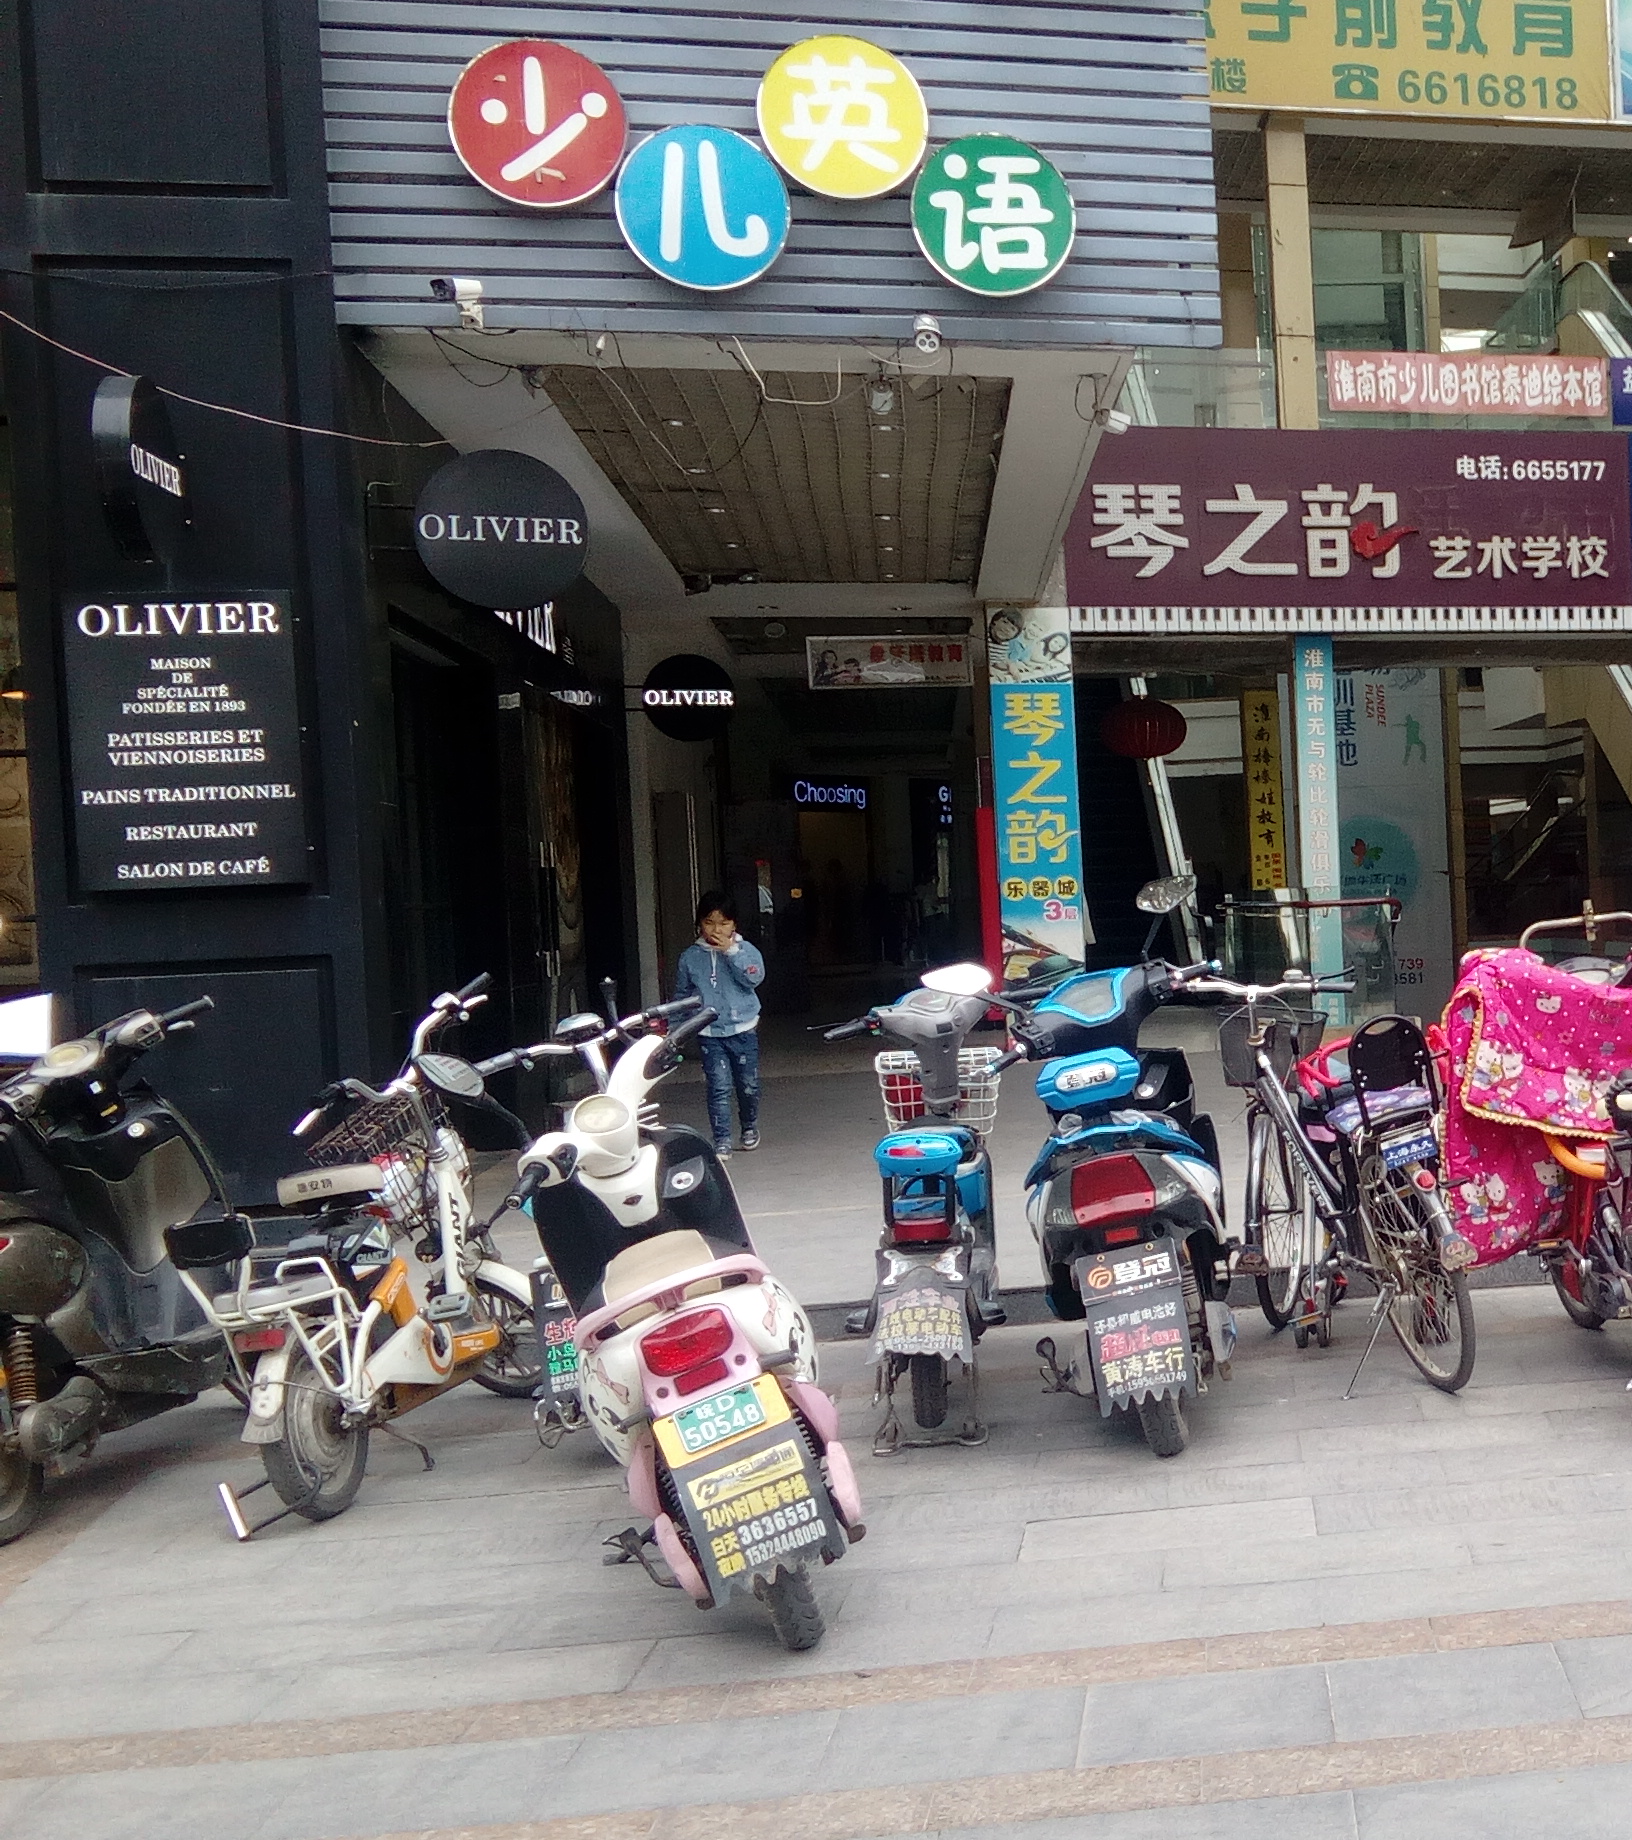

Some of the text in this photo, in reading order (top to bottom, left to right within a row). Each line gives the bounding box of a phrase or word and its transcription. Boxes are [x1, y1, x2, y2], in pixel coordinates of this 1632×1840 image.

[1397, 69, 1578, 110] 6616818
[129, 443, 183, 498] OLIVIER
[1454, 455, 1607, 482] 电话:6655177
[417, 514, 584, 545] OLIVIER
[1090, 483, 1402, 579] 琴之韵
[1428, 535, 1610, 579] 艺术学校
[76, 600, 281, 637] OLIVIER
[149, 657, 212, 670] MAISON
[136, 683, 229, 699] SPÉCIALITÉ
[171, 672, 194, 685] DE
[121, 699, 247, 714] FONDÉE EN 1893
[644, 690, 735, 706] OLIVIER
[107, 729, 264, 748] PATISSERIES ET
[108, 748, 266, 766] VIENNOISERIES
[1003, 691, 1079, 864] 琴之韵
[81, 784, 297, 805] PAINS TRADITIONNEL
[794, 780, 867, 810] Choosing
[125, 822, 258, 842] RESTAURANT
[116, 857, 271, 879] SALON DE CAFÉ
[1006, 880, 1076, 899] 乐器城
[1101, 1346, 1185, 1388] 黄涛车行
[684, 1403, 761, 1449] 50548
[737, 1497, 818, 1546] 3636557
